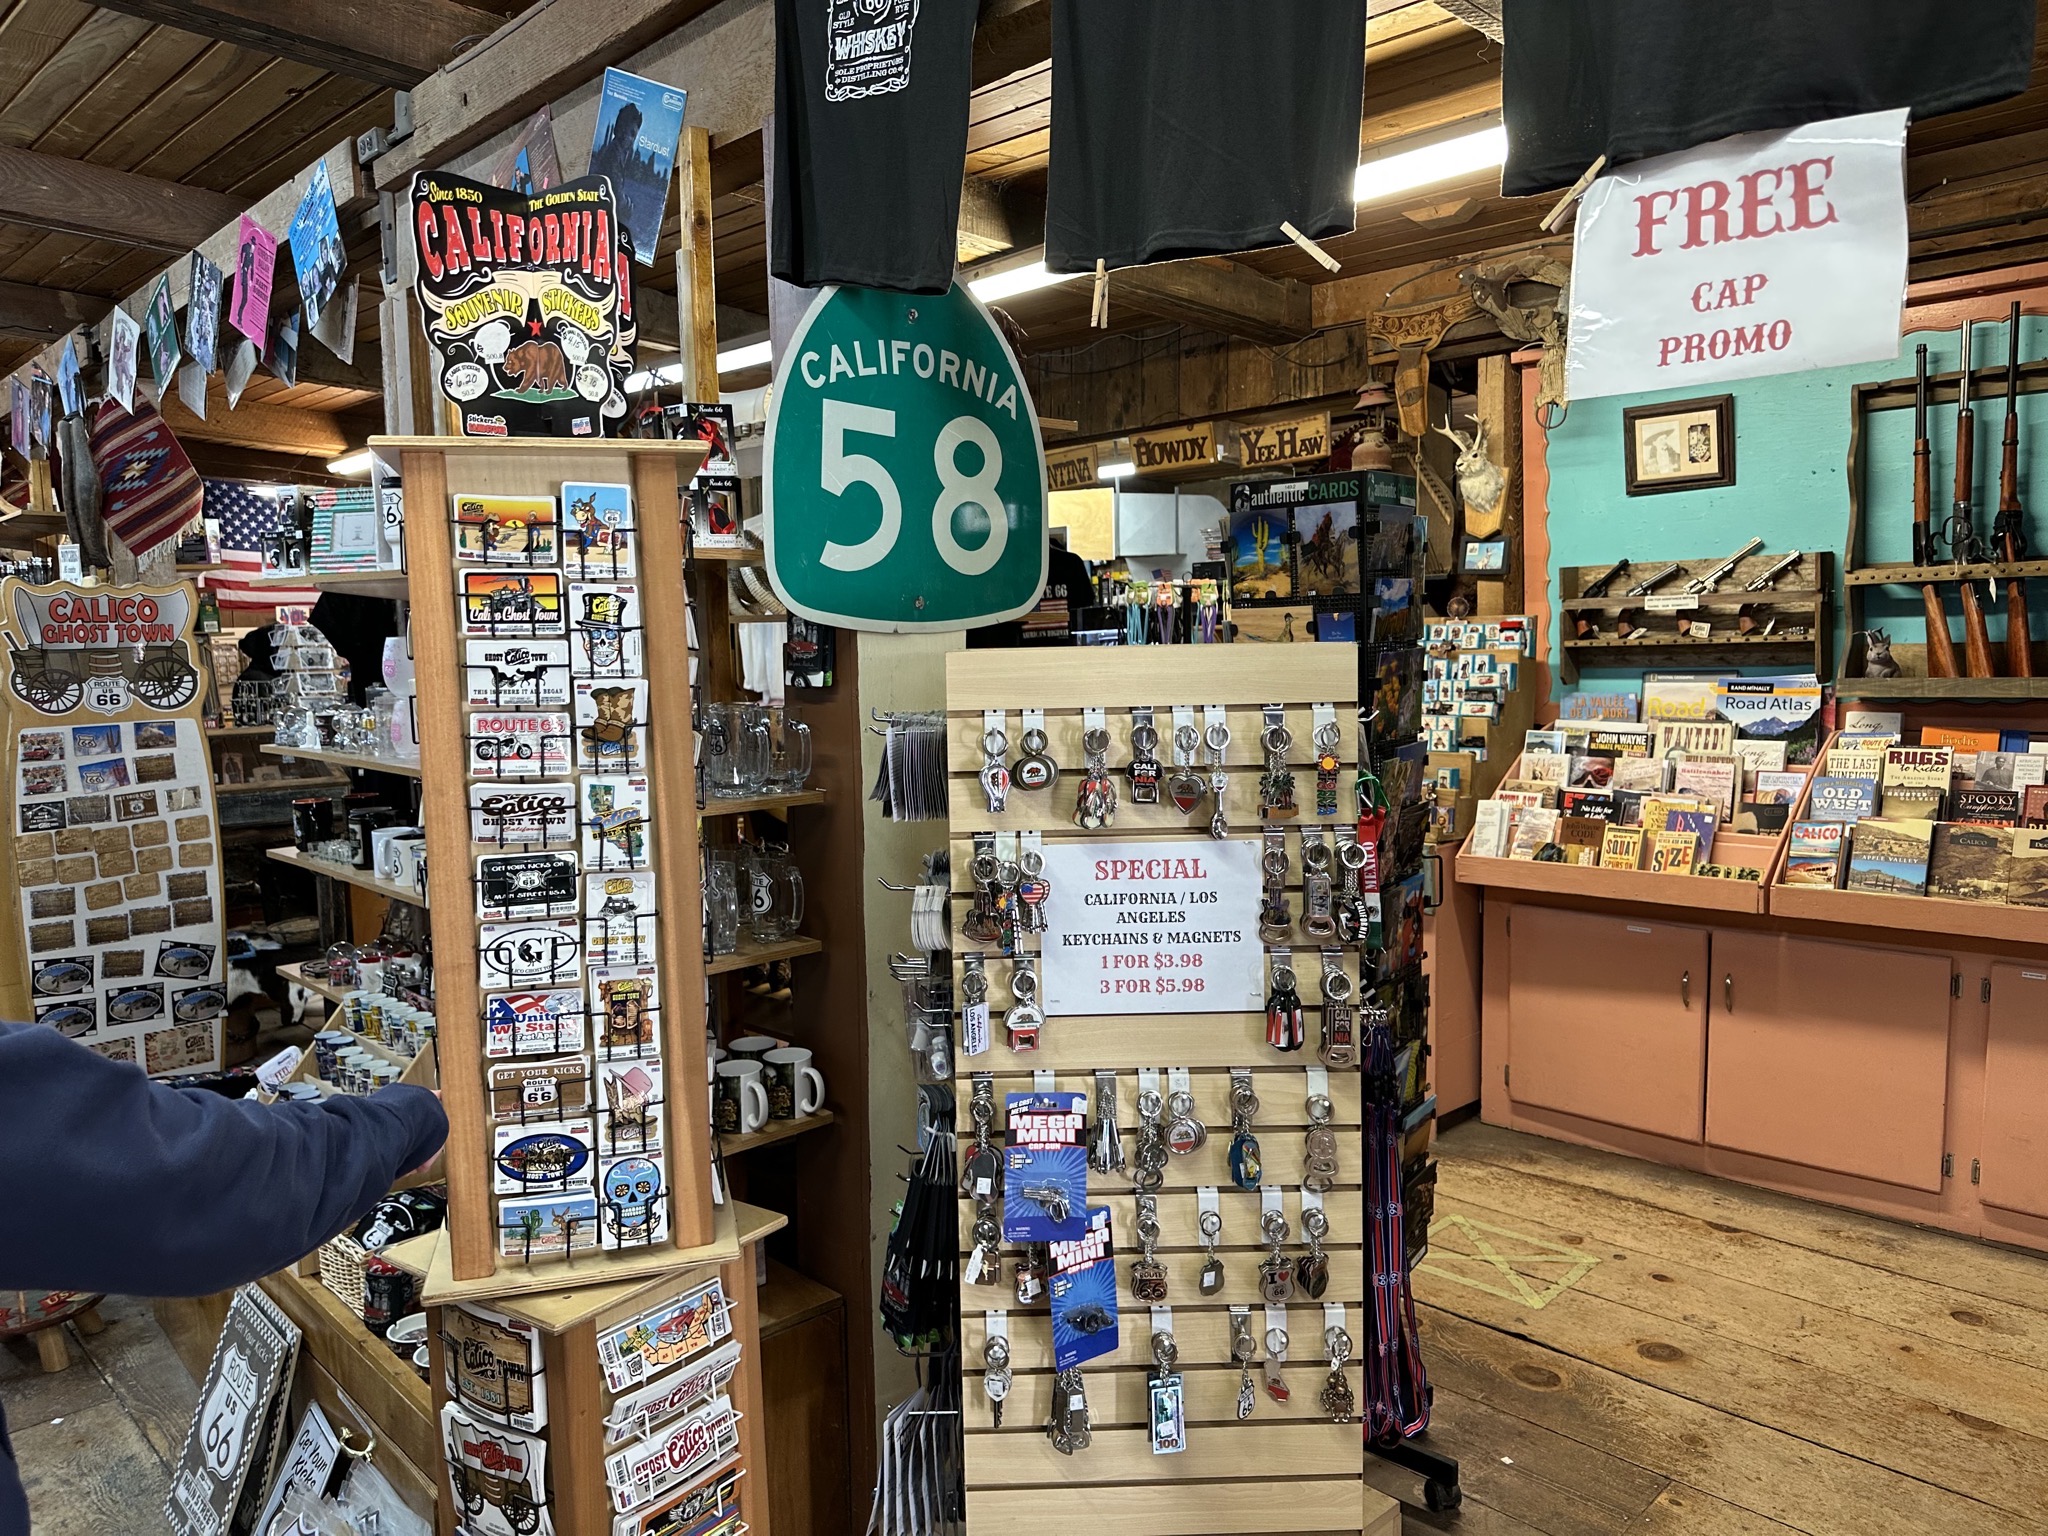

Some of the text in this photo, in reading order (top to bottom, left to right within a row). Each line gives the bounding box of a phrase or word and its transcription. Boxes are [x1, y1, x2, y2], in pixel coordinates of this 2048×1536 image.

[833, 18, 855, 29] STYLE
[835, 20, 907, 60] WHISKEY
[834, 67, 855, 77] SOLE
[638, 136, 671, 157] Stardust
[430, 182, 483, 204] Since 1850
[529, 188, 599, 212] THE GOLDEN STATE
[1631, 156, 1838, 258] FREE
[418, 200, 612, 286] CALIFORNIA
[1690, 273, 1769, 313] CAP
[445, 288, 600, 331] SOUVENIR STICKERS
[1656, 319, 1793, 368] PROMO
[801, 339, 1019, 421] CALIFORNIA
[699, 405, 713, 413] Route
[1133, 436, 1208, 468] HOWDY
[819, 399, 1009, 575] 58
[1251, 480, 1360, 507] authentic CARDS
[462, 501, 484, 513] Calico
[1055, 584, 1068, 597] 66
[49, 597, 159, 623] CALICO
[469, 606, 558, 622] Calio Ghost Town
[42, 623, 175, 643] GHOST TOWN
[1799, 681, 1818, 689] 2023
[96, 694, 121, 706] 66
[1573, 695, 1627, 708] LA VALLÉE
[1647, 697, 1707, 718] Road
[1725, 696, 1812, 711] Road Atlas
[1569, 708, 1630, 719] DE LA MORT
[1849, 716, 1883, 732] Long
[1596, 733, 1618, 744] JOHN
[1619, 733, 1647, 745] WAYNE
[1663, 725, 1726, 751] WANTED!
[1941, 734, 1979, 746] Bodie
[1590, 743, 1613, 751] ULTIMATE
[1830, 758, 1879, 770] THE LAST
[1888, 751, 1949, 765] RUGS
[1133, 763, 1157, 771] CALI
[1900, 763, 1945, 773] to Riches
[1134, 776, 1157, 784] NIA
[1822, 787, 1863, 799] OLD
[1960, 793, 2016, 805] SPOOKY
[480, 796, 567, 817] Calico
[1591, 805, 1603, 814] Life
[1603, 807, 1613, 815] for
[1813, 799, 1872, 811] WEST
[482, 817, 567, 826] GHOST TOWN
[590, 807, 641, 831] Calico
[1794, 826, 1839, 840] CALICO
[1606, 839, 1637, 855] SQUAT
[1959, 838, 1988, 846] CALICO
[1364, 841, 1378, 891] MEXICO
[1604, 860, 1633, 870] SPURS ON
[1652, 846, 1693, 872] SIZE
[1861, 854, 1919, 864] APPLE VALLEY
[1094, 858, 1208, 881] SPECIAL
[604, 878, 634, 895] Calico
[1084, 891, 1218, 906] CALIFORNIA / LOS
[1116, 911, 1186, 924] ANGELES
[1354, 900, 1370, 940] CALIFORNIA
[1062, 930, 1242, 946] KEYCHAINS & MAGNETS
[494, 936, 565, 966] CGT
[1102, 952, 1203, 970] 1 FOR $3.98
[1100, 977, 1205, 995] 3 FOR $5.98
[1334, 1010, 1350, 1021] CALI
[1334, 1021, 1350, 1031] FOR
[970, 1023, 978, 1054] ANGELES
[1334, 1032, 1350, 1043] NIA
[497, 1066, 582, 1080] GET YOUR KICKS
[527, 1091, 552, 1103] 66
[1009, 1098, 1034, 1110] DIE CAST
[1011, 1106, 1029, 1116] METAL
[1009, 1114, 1083, 1130] MEGA
[1016, 1128, 1076, 1143] MINI
[1057, 1243, 1106, 1271] MINI
[1067, 1260, 1094, 1275] CAP GUN
[1139, 1271, 1163, 1279] ROUTE
[1268, 1272, 1277, 1284] I
[1138, 1283, 1166, 1299] 66
[242, 1326, 257, 1347] Your
[463, 1336, 525, 1383] Calico TOWN
[227, 1357, 254, 1401] ROUTE
[225, 1392, 238, 1416] US
[481, 1387, 501, 1405] 1881
[1242, 1402, 1253, 1416] 66
[206, 1412, 235, 1469] 66
[1157, 1438, 1179, 1449] 100
[298, 1430, 328, 1473] Get Your
[635, 1453, 667, 1482] GHOST
[666, 1420, 706, 1471] Calico
[291, 1456, 317, 1489] Kicks
[182, 1474, 217, 1529] MAIN STREET
